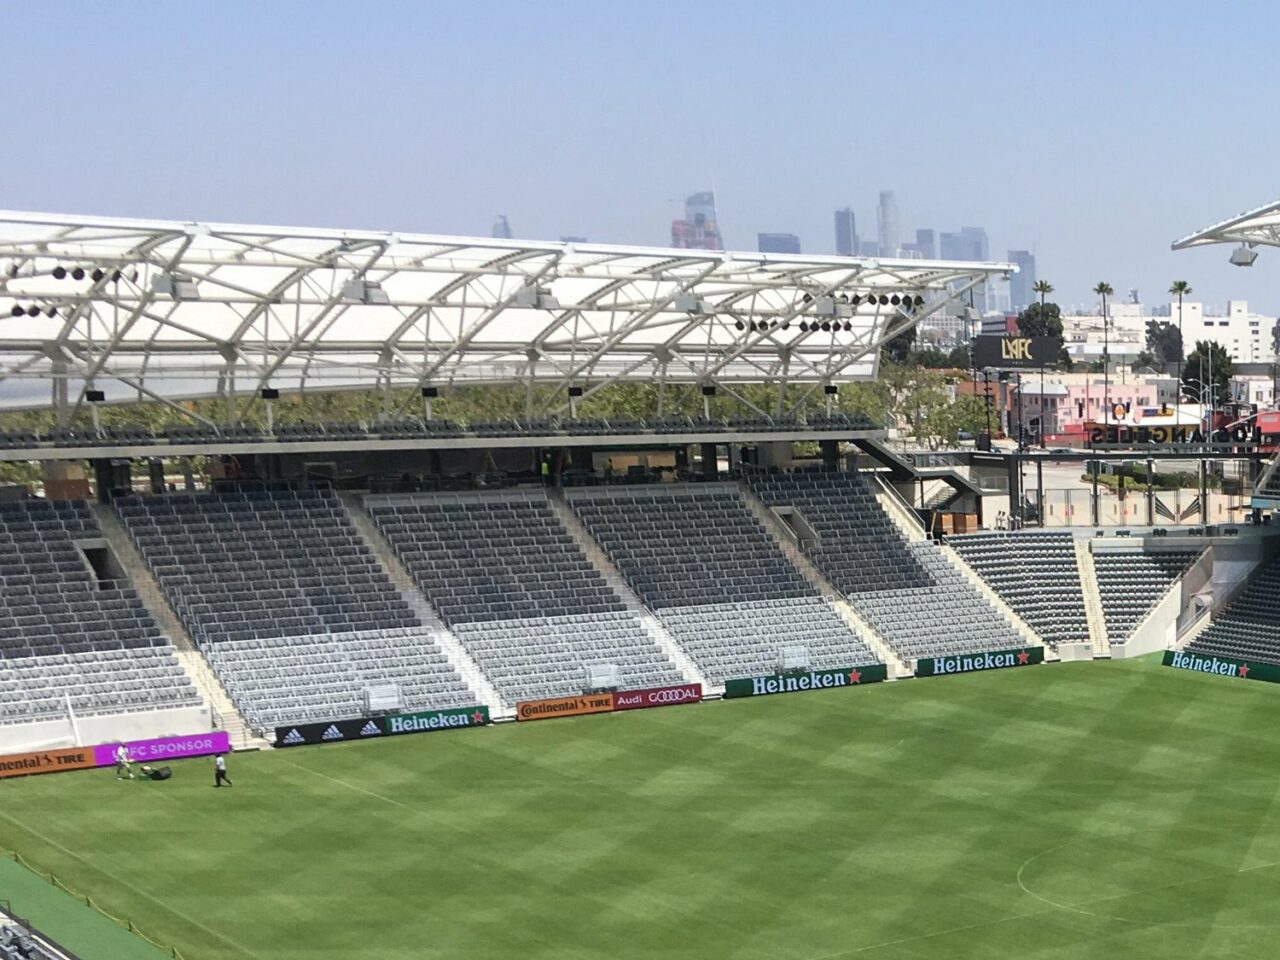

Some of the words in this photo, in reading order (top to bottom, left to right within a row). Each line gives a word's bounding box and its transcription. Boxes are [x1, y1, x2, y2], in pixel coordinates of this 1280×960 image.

[1001, 338, 1033, 360] LAFC
[932, 650, 1015, 675] Heineken
[1171, 652, 1237, 676] Heineken
[752, 672, 846, 696] Heineken
[521, 699, 579, 718] Continental
[588, 698, 611, 708] TIRE
[617, 694, 643, 706] Audi
[391, 713, 469, 733] Heineken
[56, 753, 86, 765] TIRE
[112, 746, 147, 759] LFC
[151, 739, 214, 756] SPONSOR
